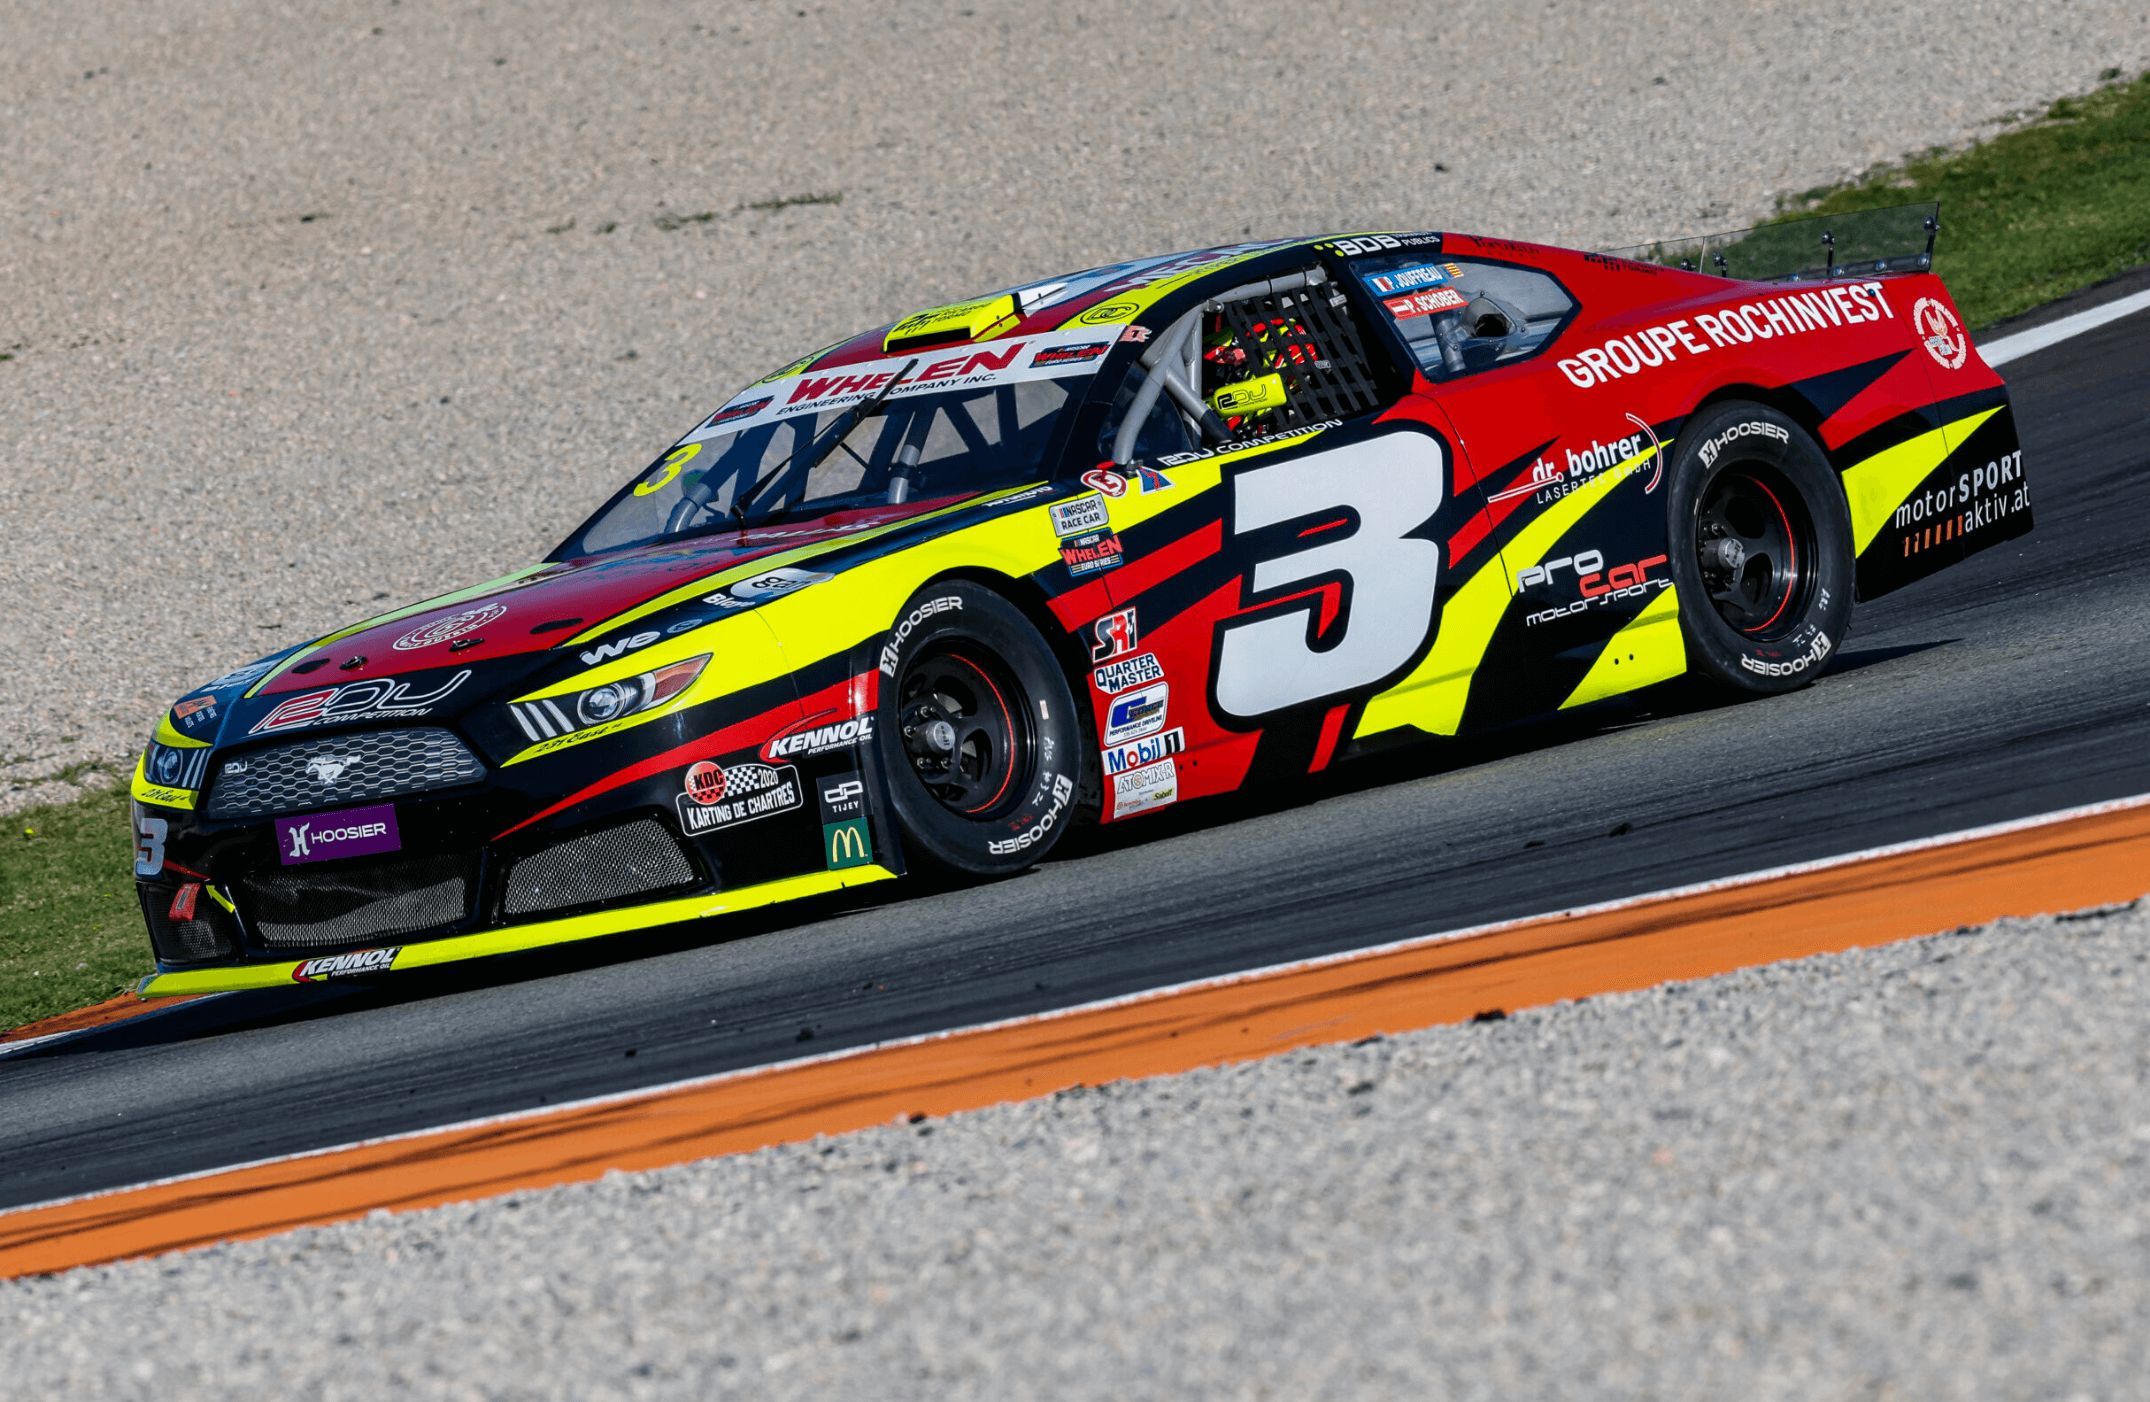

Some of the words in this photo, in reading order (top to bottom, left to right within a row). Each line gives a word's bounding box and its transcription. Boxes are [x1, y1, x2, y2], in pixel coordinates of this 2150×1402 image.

[1557, 319, 1711, 389] GROUPE
[1698, 282, 1894, 346] ROCHINVEST
[776, 391, 875, 415] ENGINEERING
[886, 378, 961, 395] OMPANY
[963, 374, 996, 384] INC.
[1217, 418, 1343, 454] COMPETITION
[1714, 422, 1789, 451] HOOSIER
[633, 443, 702, 496] 3
[1566, 434, 1641, 477] bohrer
[1536, 473, 1606, 504] LASERTEC
[1895, 449, 2022, 529] motorSPORT
[1061, 518, 1083, 530] RACE
[1083, 512, 1101, 525] CAR
[1066, 500, 1097, 517] NASCAR
[1965, 481, 2031, 533] aktiv.at
[1059, 534, 1123, 566] WHELEN
[1217, 431, 1443, 716] 3
[892, 596, 963, 653] HOOSIER
[1096, 654, 1155, 687] QUARTER
[1108, 665, 1161, 693] MASTER
[1741, 649, 1817, 676] HOOSIER
[312, 707, 433, 726] COMPETITION
[768, 718, 872, 758] KENNOL
[808, 739, 857, 754] PERFORMANCE
[859, 734, 873, 742] OIL
[1107, 737, 1161, 773] Mobil
[694, 769, 724, 791] KDC
[758, 769, 780, 789] 2020
[687, 804, 732, 830] KARTING
[733, 803, 747, 818] DE
[748, 781, 796, 814] CHARTRES
[832, 801, 860, 813] TIJEY
[311, 822, 386, 845] HOOSIER
[988, 799, 1062, 854] HOOSIER
[135, 817, 169, 876] 3
[299, 948, 395, 977] KENNOL
